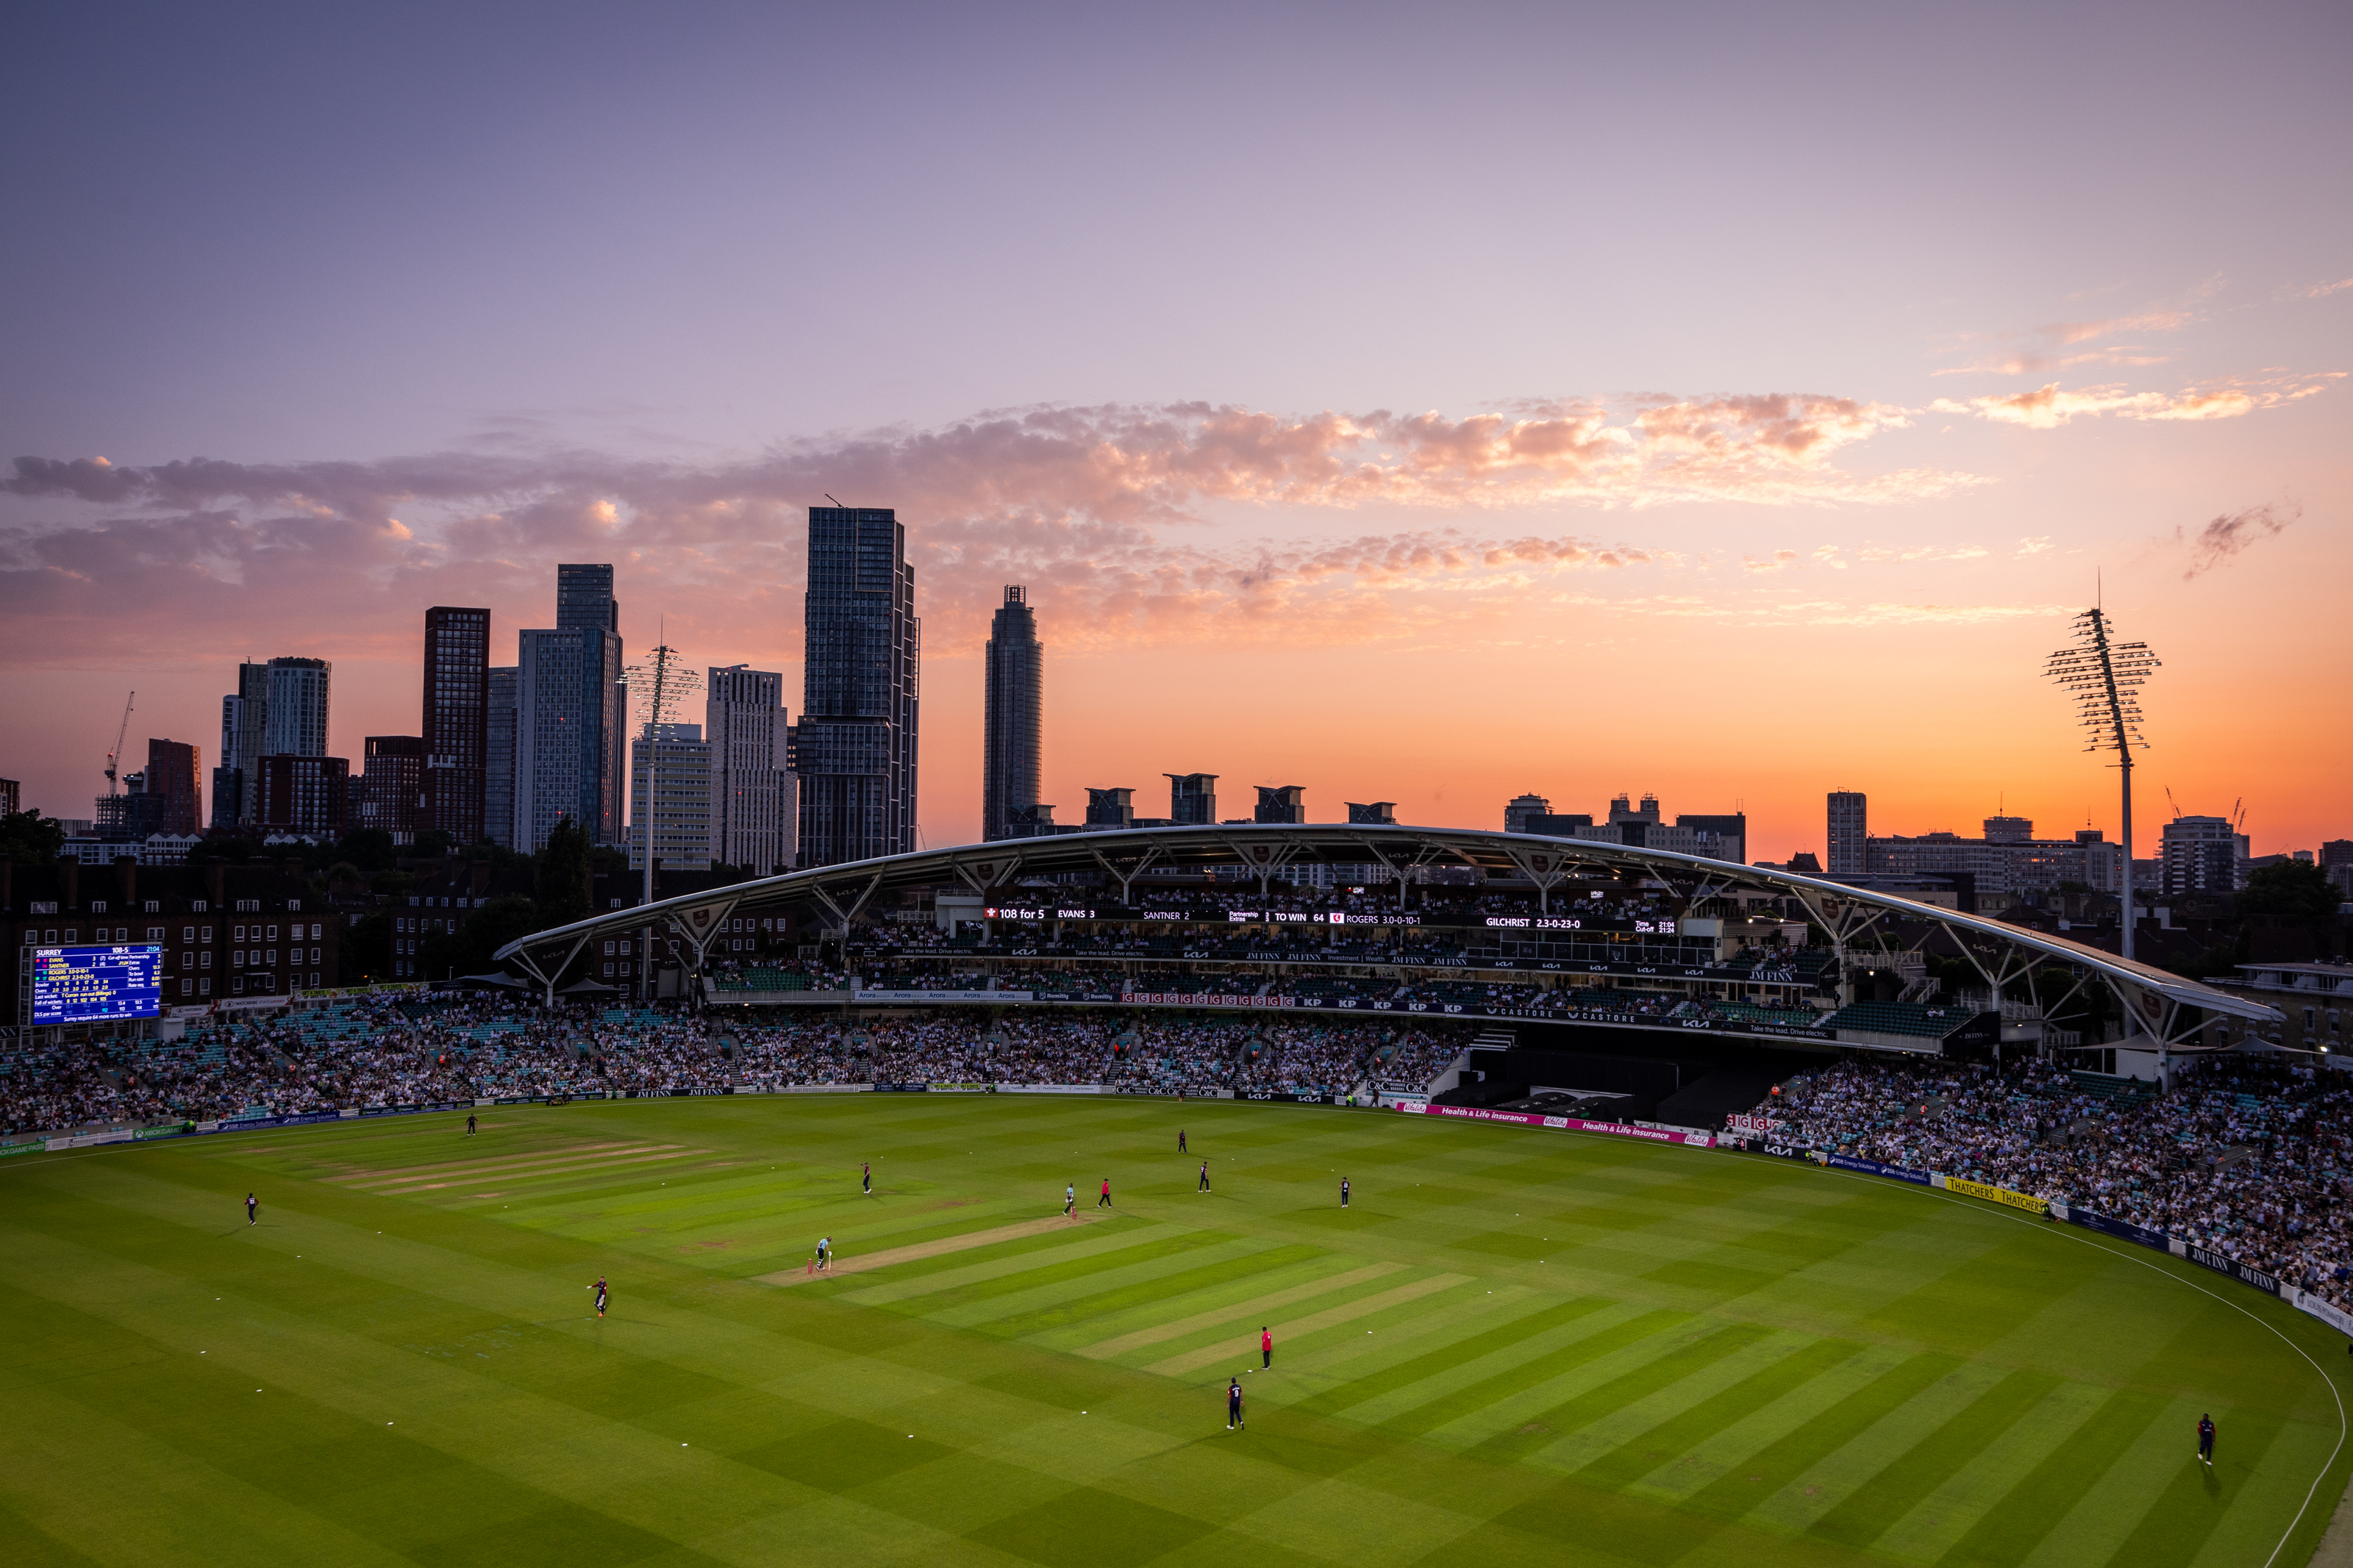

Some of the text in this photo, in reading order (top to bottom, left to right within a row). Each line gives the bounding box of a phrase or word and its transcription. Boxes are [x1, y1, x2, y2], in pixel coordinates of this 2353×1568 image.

[999, 909, 1044, 918] 108 for 5
[1275, 913, 1324, 922] TO WIN 64
[1346, 915, 1420, 924] ROGERS 3.0-0-10-1
[1487, 918, 1580, 928] GILCHRIST 2.3-0-23-0
[1447, 958, 1467, 966] FINN
[1749, 971, 1793, 982] JM FINN
[1254, 997, 1263, 1005] IG
[1268, 997, 1278, 1005] IG
[1283, 998, 1292, 1006] IG
[1339, 1000, 1356, 1008] KP
[1501, 1008, 1552, 1017] CASTORE
[1582, 1013, 1635, 1023] CASTORE
[1117, 1086, 1135, 1094] C&C
[1149, 1086, 1166, 1095] C&C
[1368, 1081, 1389, 1090] C&C
[1406, 1083, 1427, 1093] C&C
[1405, 1103, 1426, 1113] Vitality
[1442, 1108, 1467, 1116] Health
[1491, 1112, 1527, 1122] insurance
[1738, 1117, 1749, 1127] IG
[1754, 1118, 1765, 1130] IG
[1544, 1116, 1566, 1128] Vitality
[1582, 1122, 1607, 1132] Health
[1616, 1126, 1631, 1134] Life
[1632, 1128, 1669, 1139] insurance
[1685, 1134, 1707, 1146] Vitality
[1844, 1159, 1857, 1169] Energy
[1858, 1161, 1876, 1170] Solutions
[1896, 1169, 1910, 1178] Energy
[1949, 1178, 1994, 1199] THATCHERS
[2002, 1191, 2043, 1212] THATCHERS
[2193, 1247, 2227, 1271] JM FINN
[2239, 1265, 2274, 1291] JM FINN
[2307, 1299, 2321, 1314] LOUIS
